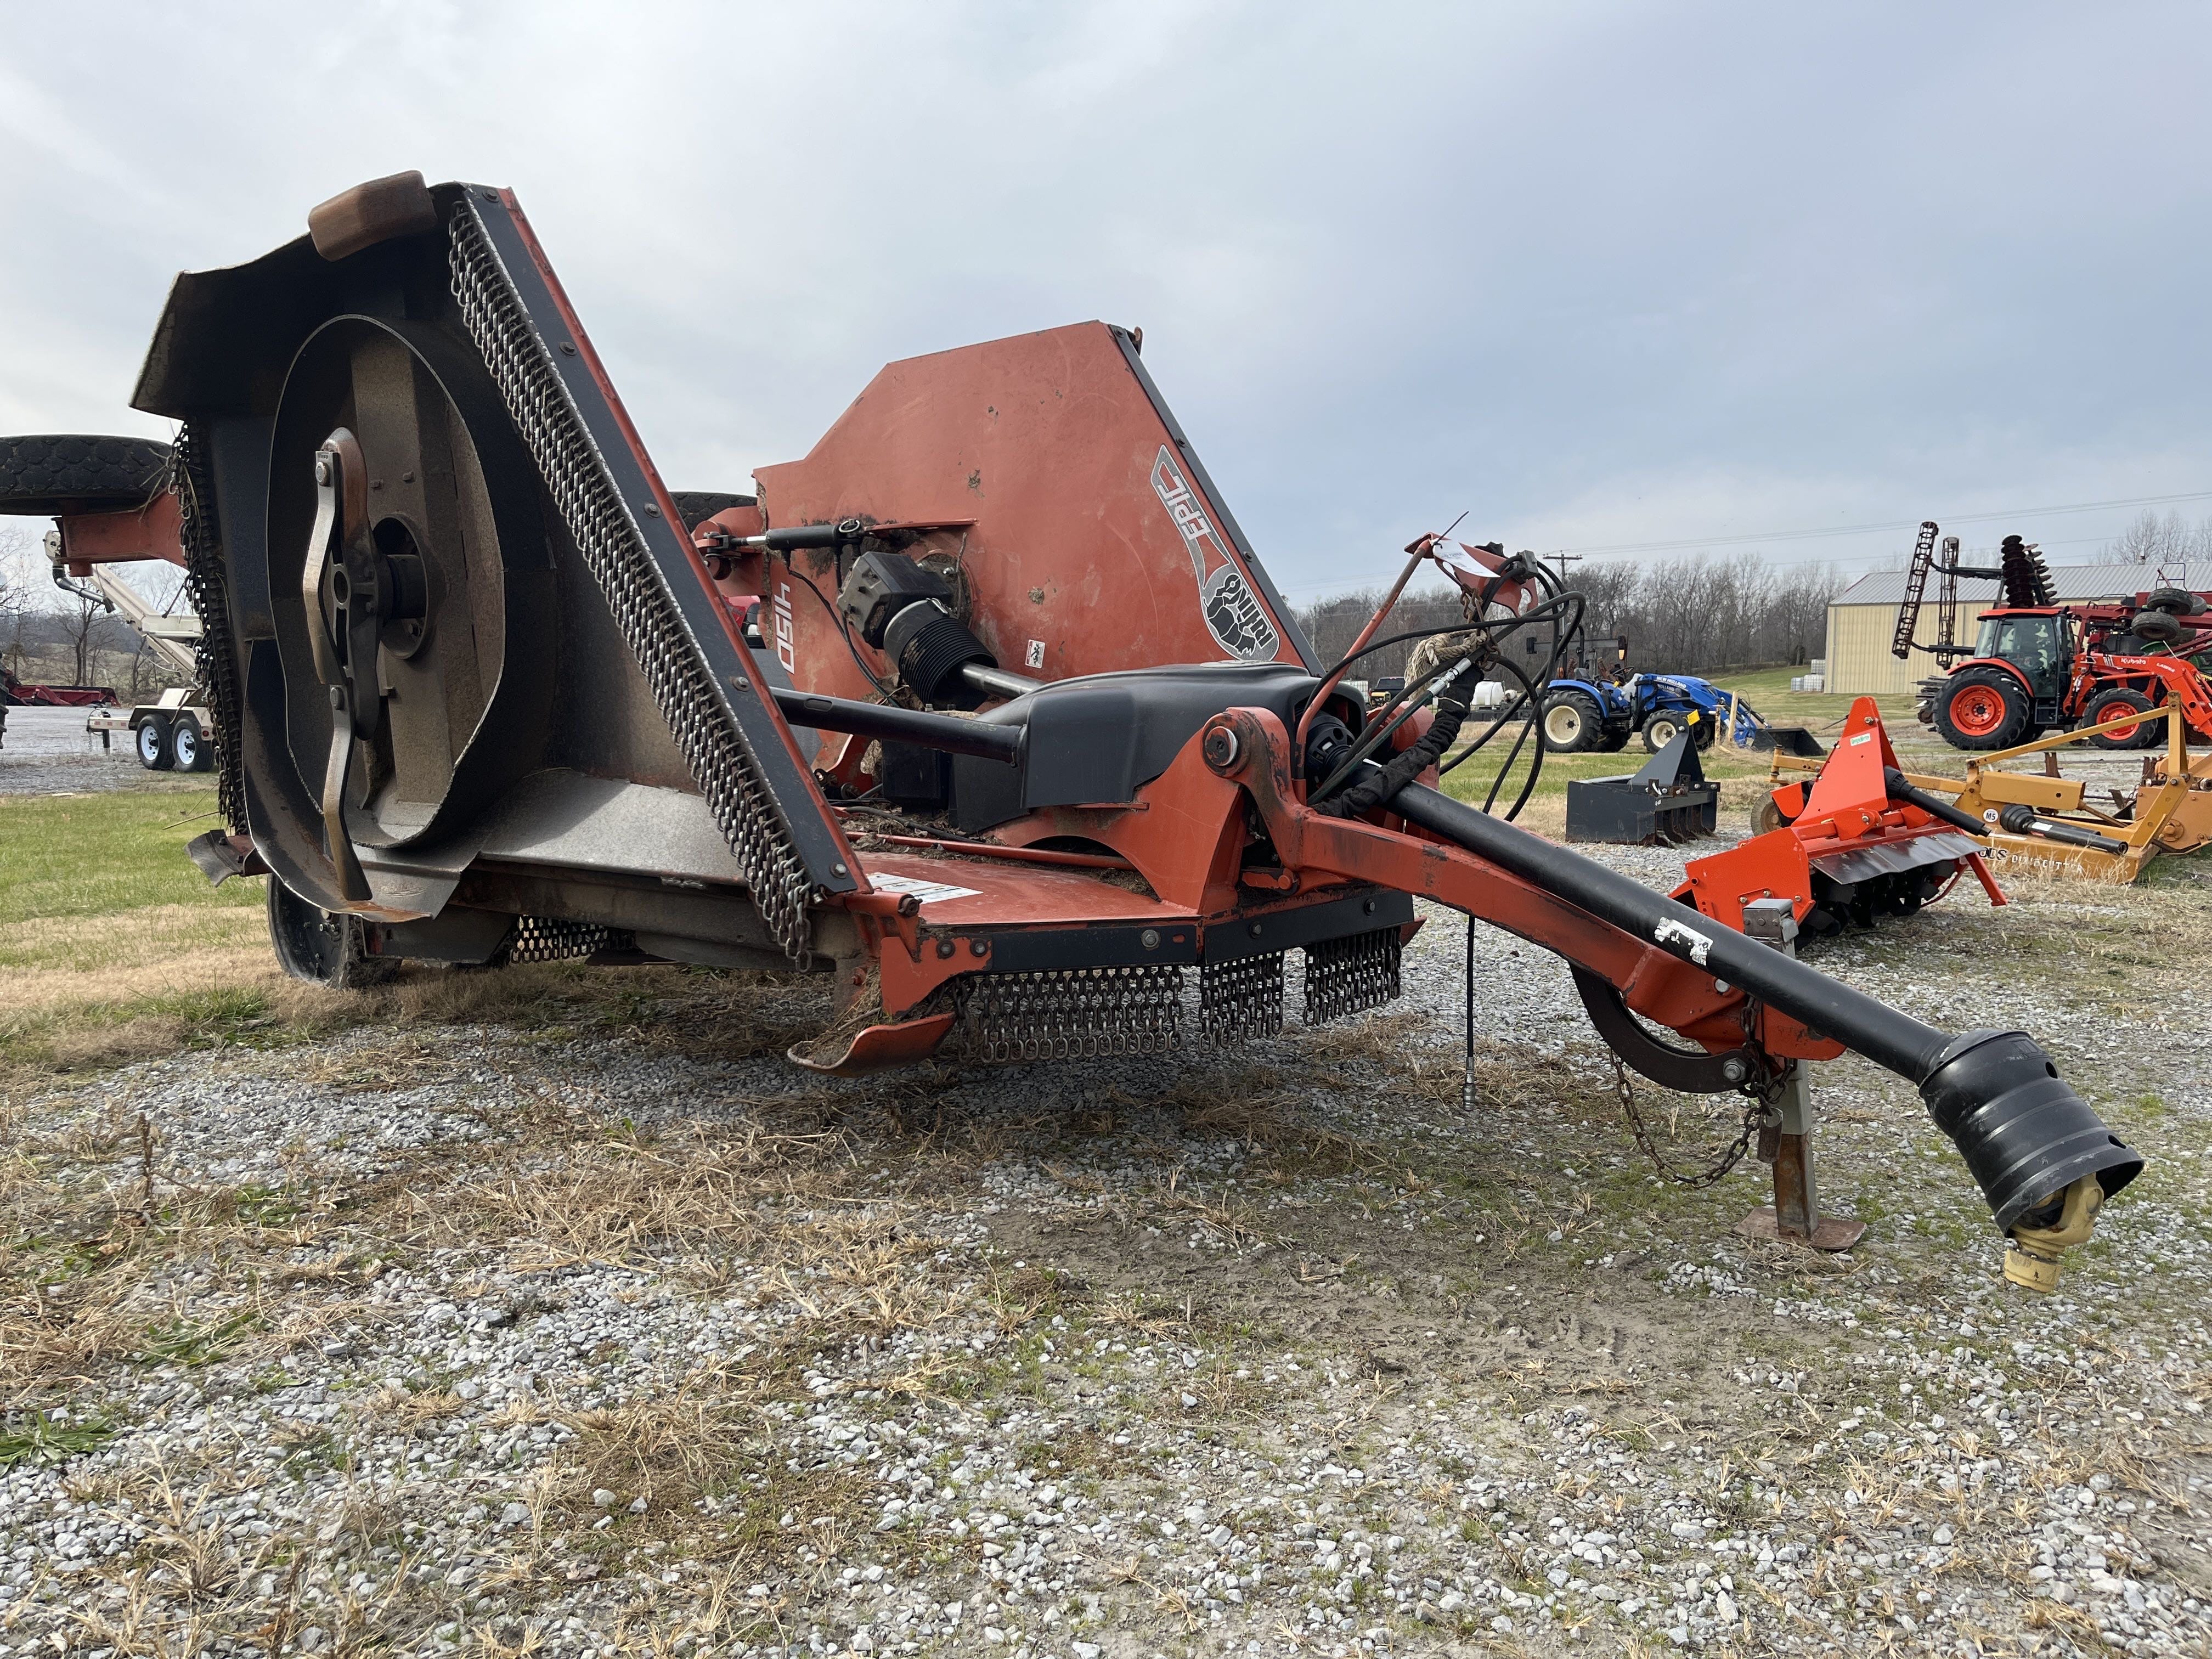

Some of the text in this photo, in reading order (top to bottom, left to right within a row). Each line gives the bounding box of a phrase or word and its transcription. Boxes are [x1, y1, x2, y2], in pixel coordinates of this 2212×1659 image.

[1157, 475, 1211, 540] EPIC
[774, 582, 795, 674] 4150
[1223, 574, 1276, 649] RHINO
[1667, 678, 1687, 689] HOLLAND
[1985, 812, 1996, 821] M5
[1977, 847, 2007, 861] ODS
